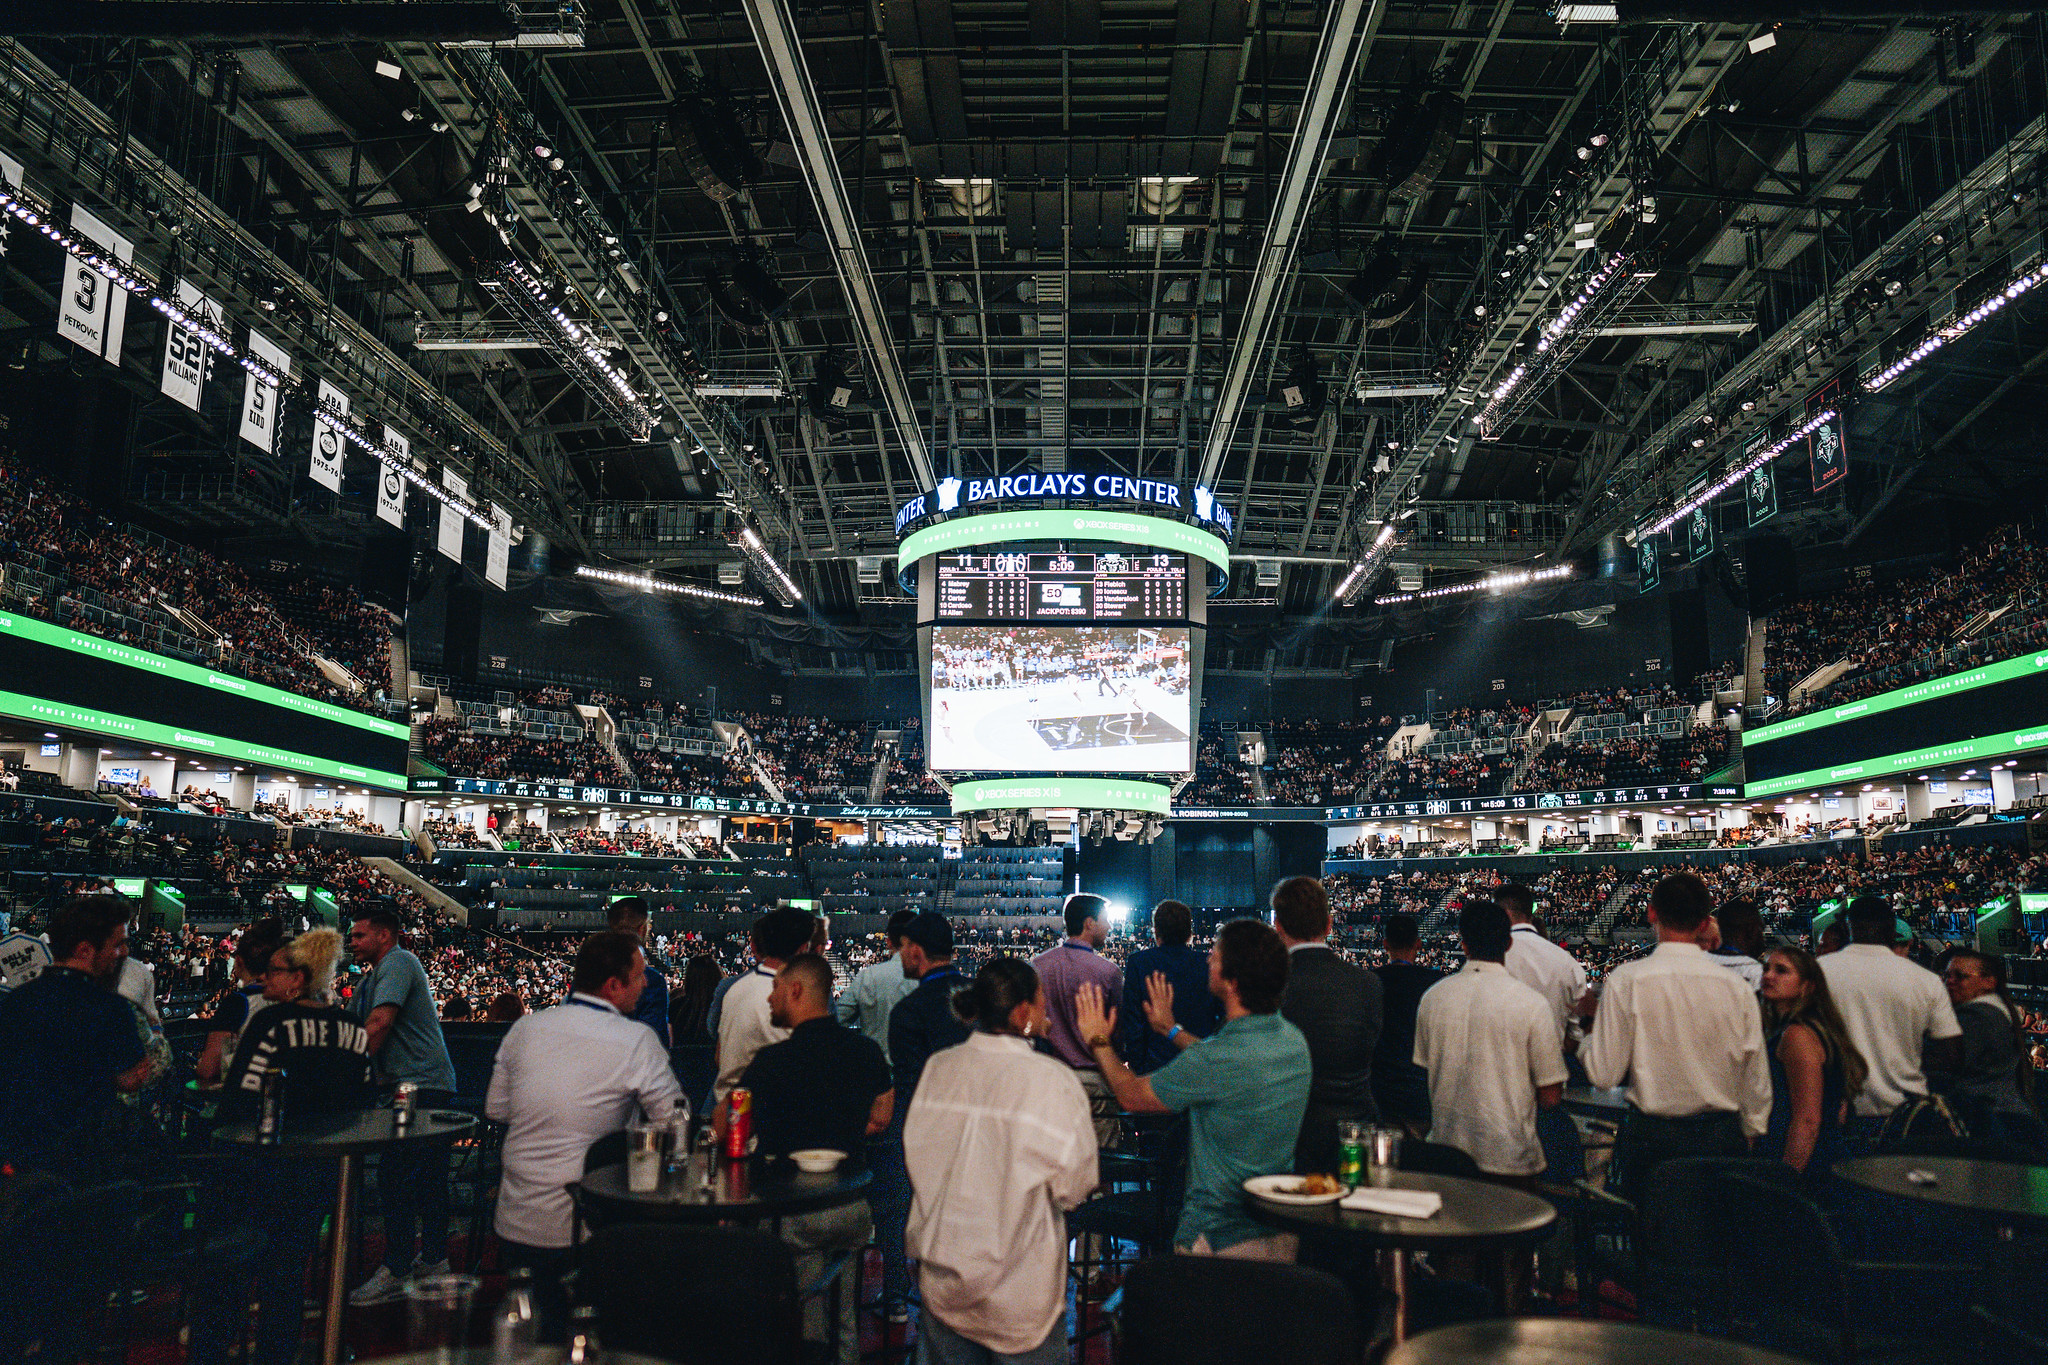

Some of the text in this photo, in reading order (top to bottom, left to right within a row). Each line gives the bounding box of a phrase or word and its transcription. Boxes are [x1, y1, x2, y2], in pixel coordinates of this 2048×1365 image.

[73, 267, 98, 314] 3
[64, 314, 99, 341] PETROVIC
[169, 323, 201, 371] 52
[167, 358, 198, 386] WILLIAMS
[325, 393, 342, 412] ABA
[248, 409, 265, 429] KIDD
[389, 438, 403, 455] ABA
[313, 456, 339, 478] 1975-76
[1822, 467, 1838, 480] 2023
[968, 474, 1181, 508] BARCLAYS CENTER
[1086, 520, 1109, 529] XBOX
[1109, 521, 1136, 531] SERIES
[958, 554, 972, 567] 11
[1049, 561, 1075, 571] 5:09
[1152, 554, 1169, 567] 13
[270, 564, 287, 572] 227
[1855, 570, 1871, 578] 205
[71, 637, 167, 669] POWER YOUR DREAMS
[1646, 663, 1660, 671] 204
[32, 704, 136, 731] POWER YOUR DREAMS
[620, 792, 631, 802] 11
[670, 796, 683, 806] 13
[985, 789, 1007, 798] XBOX
[1007, 788, 1041, 798] SERIES
[1106, 790, 1146, 799] POWER
[1460, 800, 1471, 811] 11
[1490, 800, 1505, 808] 5:09
[1512, 797, 1526, 807] 13
[840, 806, 870, 817] Liberty
[871, 808, 893, 817] Ring
[1178, 810, 1219, 818] ROBINSON
[2, 951, 24, 965] BALL
[10, 954, 32, 969] PLAY
[282, 1018, 330, 1048] THE
